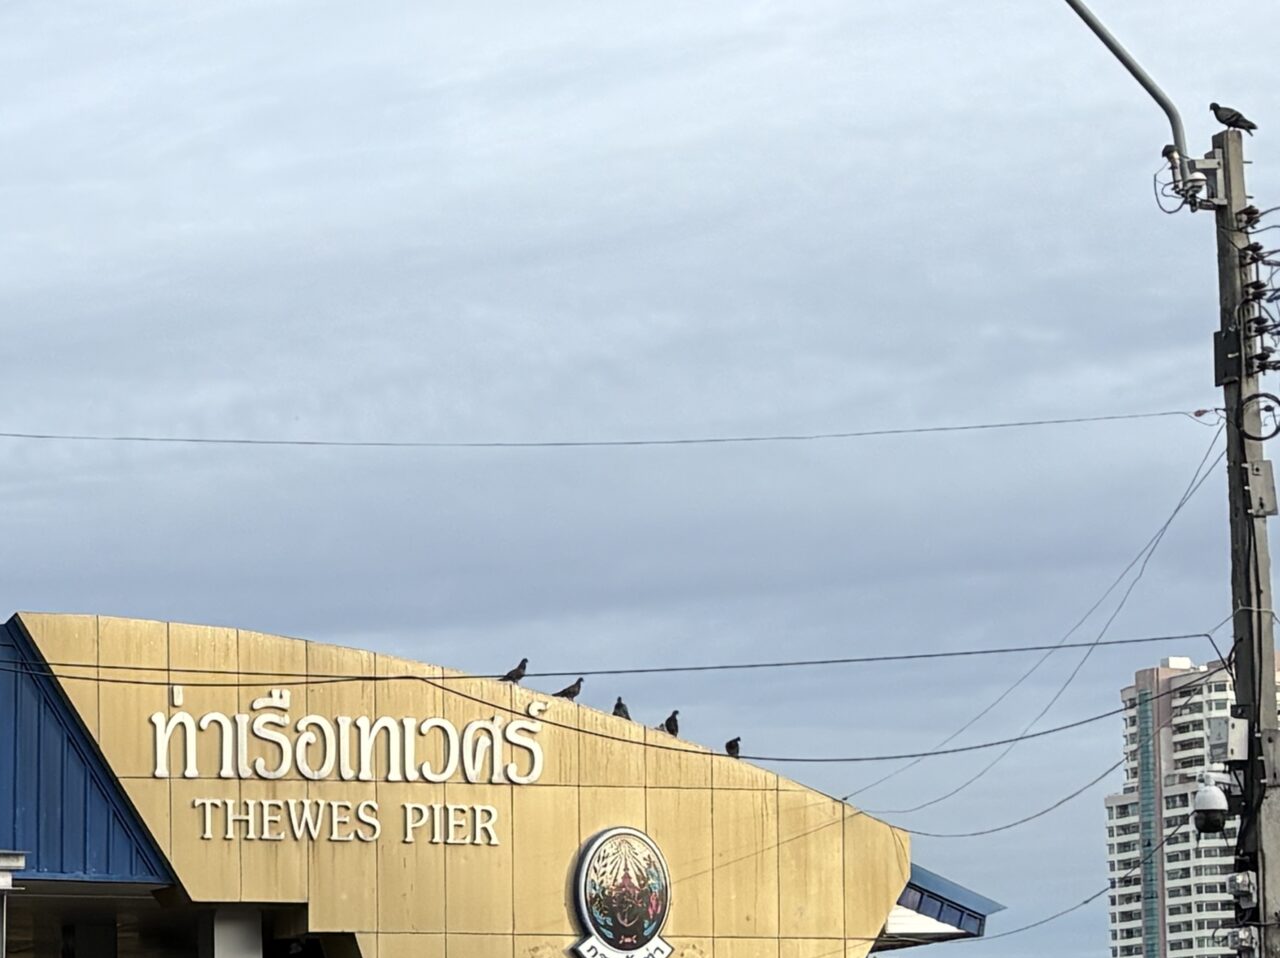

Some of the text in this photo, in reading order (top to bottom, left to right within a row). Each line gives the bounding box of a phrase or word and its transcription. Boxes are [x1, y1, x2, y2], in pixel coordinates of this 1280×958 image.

[150, 684, 549, 785] ท่าเรือเทเวศร์
[193, 798, 501, 846] THEWES PIER
